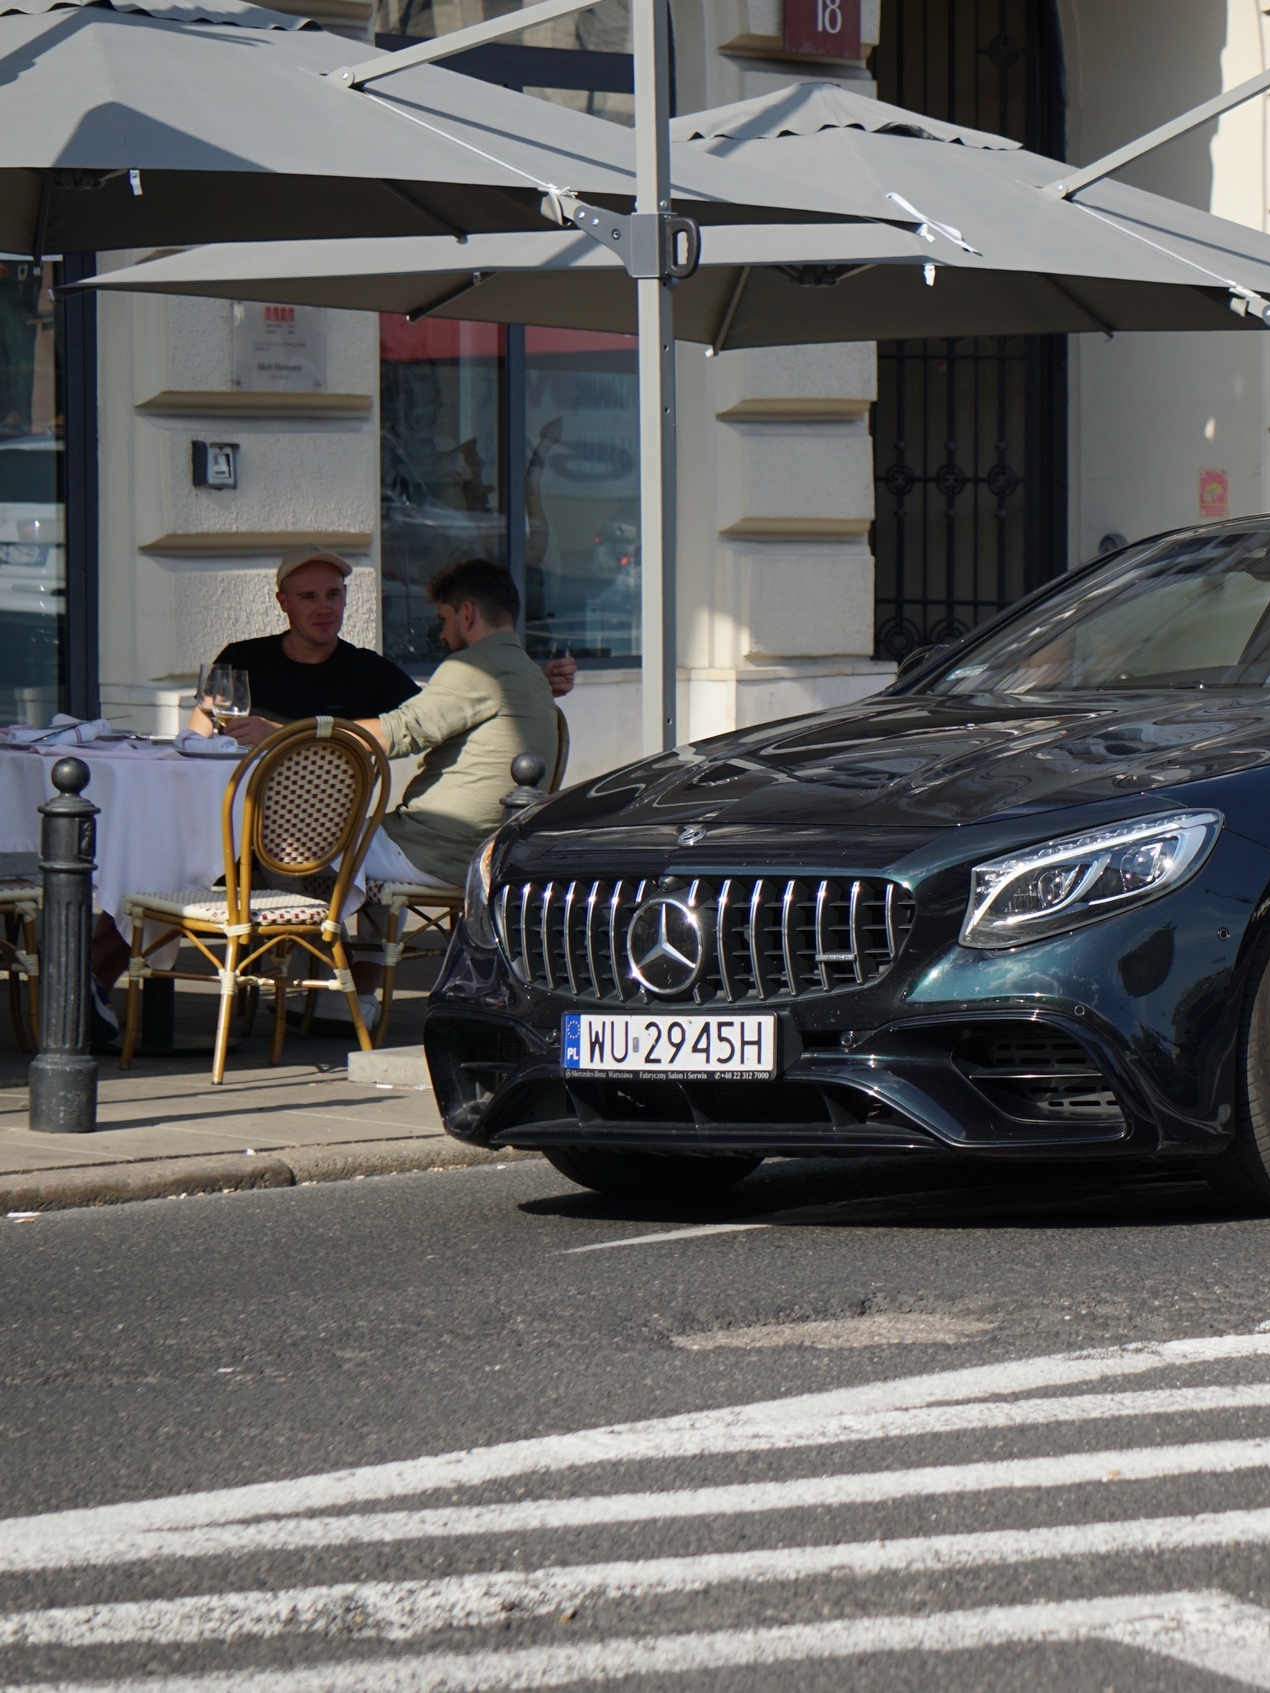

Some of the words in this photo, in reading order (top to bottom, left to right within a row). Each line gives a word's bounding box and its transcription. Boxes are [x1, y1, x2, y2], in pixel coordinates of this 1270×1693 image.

[817, 0, 842, 34] 18
[566, 1048, 580, 1060] PL
[588, 1021, 629, 1063] WU
[644, 1021, 762, 1065] 2945H
[572, 1070, 606, 1078] Mercedes-Benz
[608, 1070, 633, 1079] Warszawa
[640, 1071, 667, 1081] Fabryczny
[668, 1071, 683, 1080] Salon
[688, 1072, 708, 1080] Serwis
[733, 1072, 741, 1080] 22
[742, 1072, 753, 1080] 312
[754, 1072, 769, 1080] 7000
